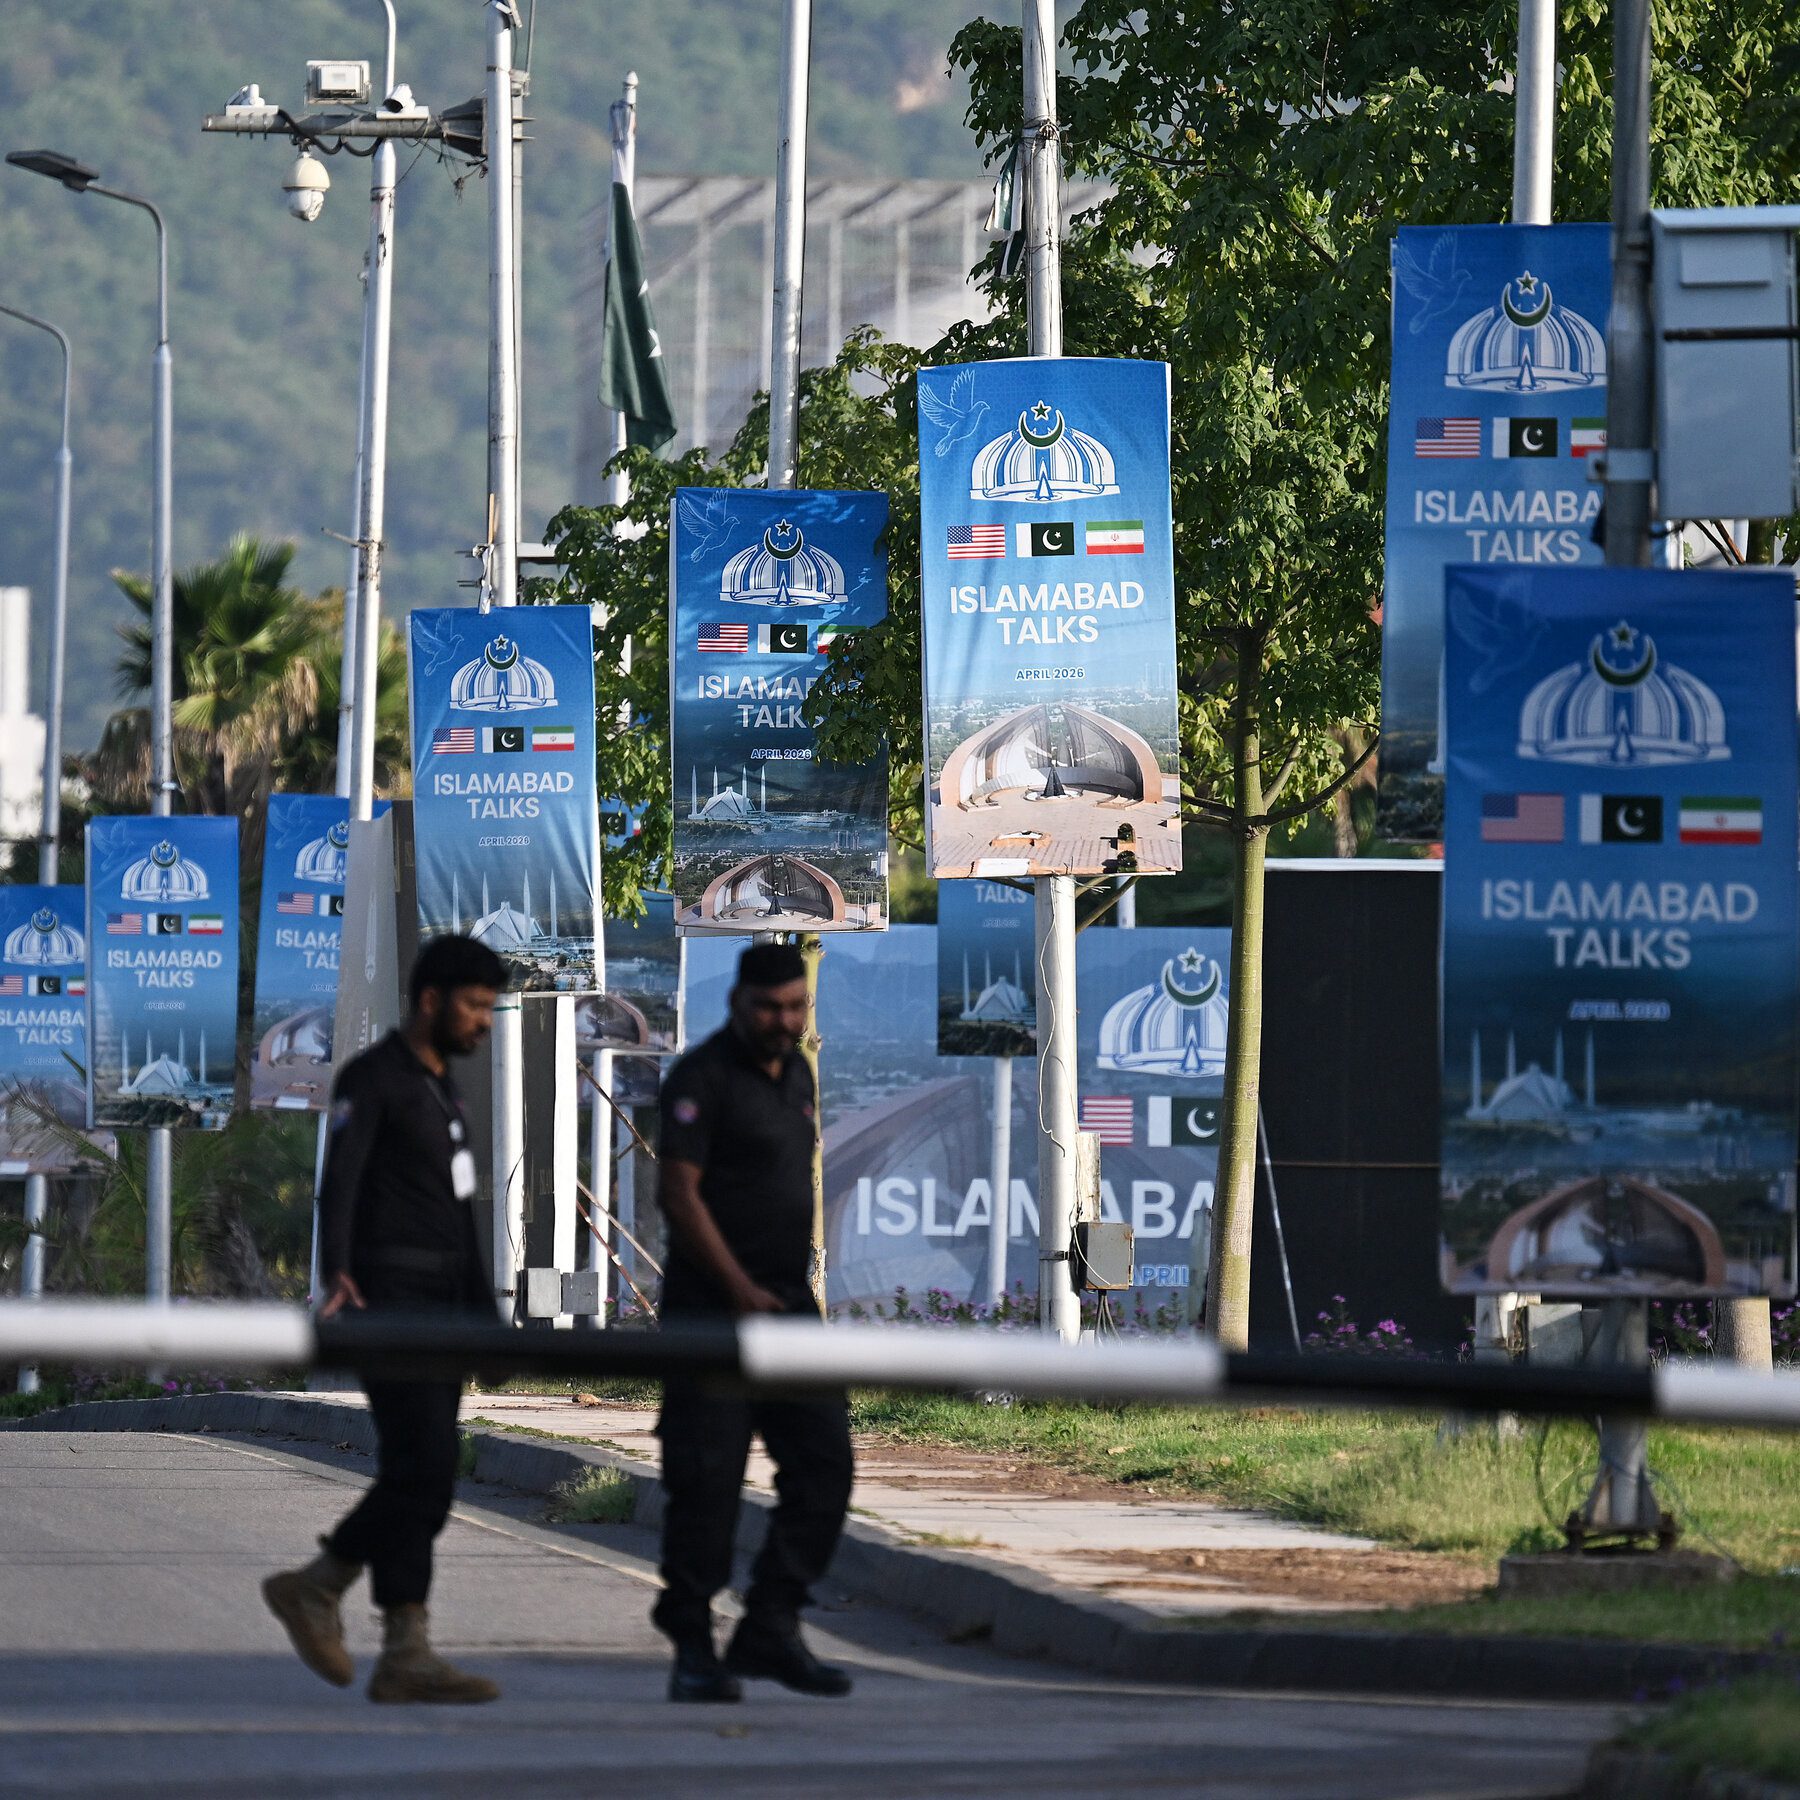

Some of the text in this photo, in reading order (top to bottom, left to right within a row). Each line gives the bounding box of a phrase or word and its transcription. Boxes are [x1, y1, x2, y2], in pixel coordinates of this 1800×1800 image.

[1414, 489, 1602, 524] ISLAMABA
[1466, 529, 1581, 564] TALKS
[950, 581, 1145, 614] ISLAMABAD
[996, 614, 1099, 645] TALKS
[1015, 667, 1084, 681] APRIL 2026
[698, 675, 818, 700] ISLAMA
[737, 704, 825, 729] TALK
[750, 749, 812, 760] APRIL 2026
[434, 771, 574, 797] ISLAMABAD
[466, 797, 541, 819] TALKS
[479, 836, 505, 847] APRIL
[1481, 878, 1760, 923] ISLAMABAD
[275, 928, 340, 950] ISLAM
[1545, 926, 1693, 970] TALKS
[107, 949, 223, 968] ISLAMABAD
[302, 951, 340, 970] TAL
[134, 969, 195, 988] TALKS
[0, 1009, 85, 1027] SLAMABA
[15, 1027, 75, 1045] TALKS
